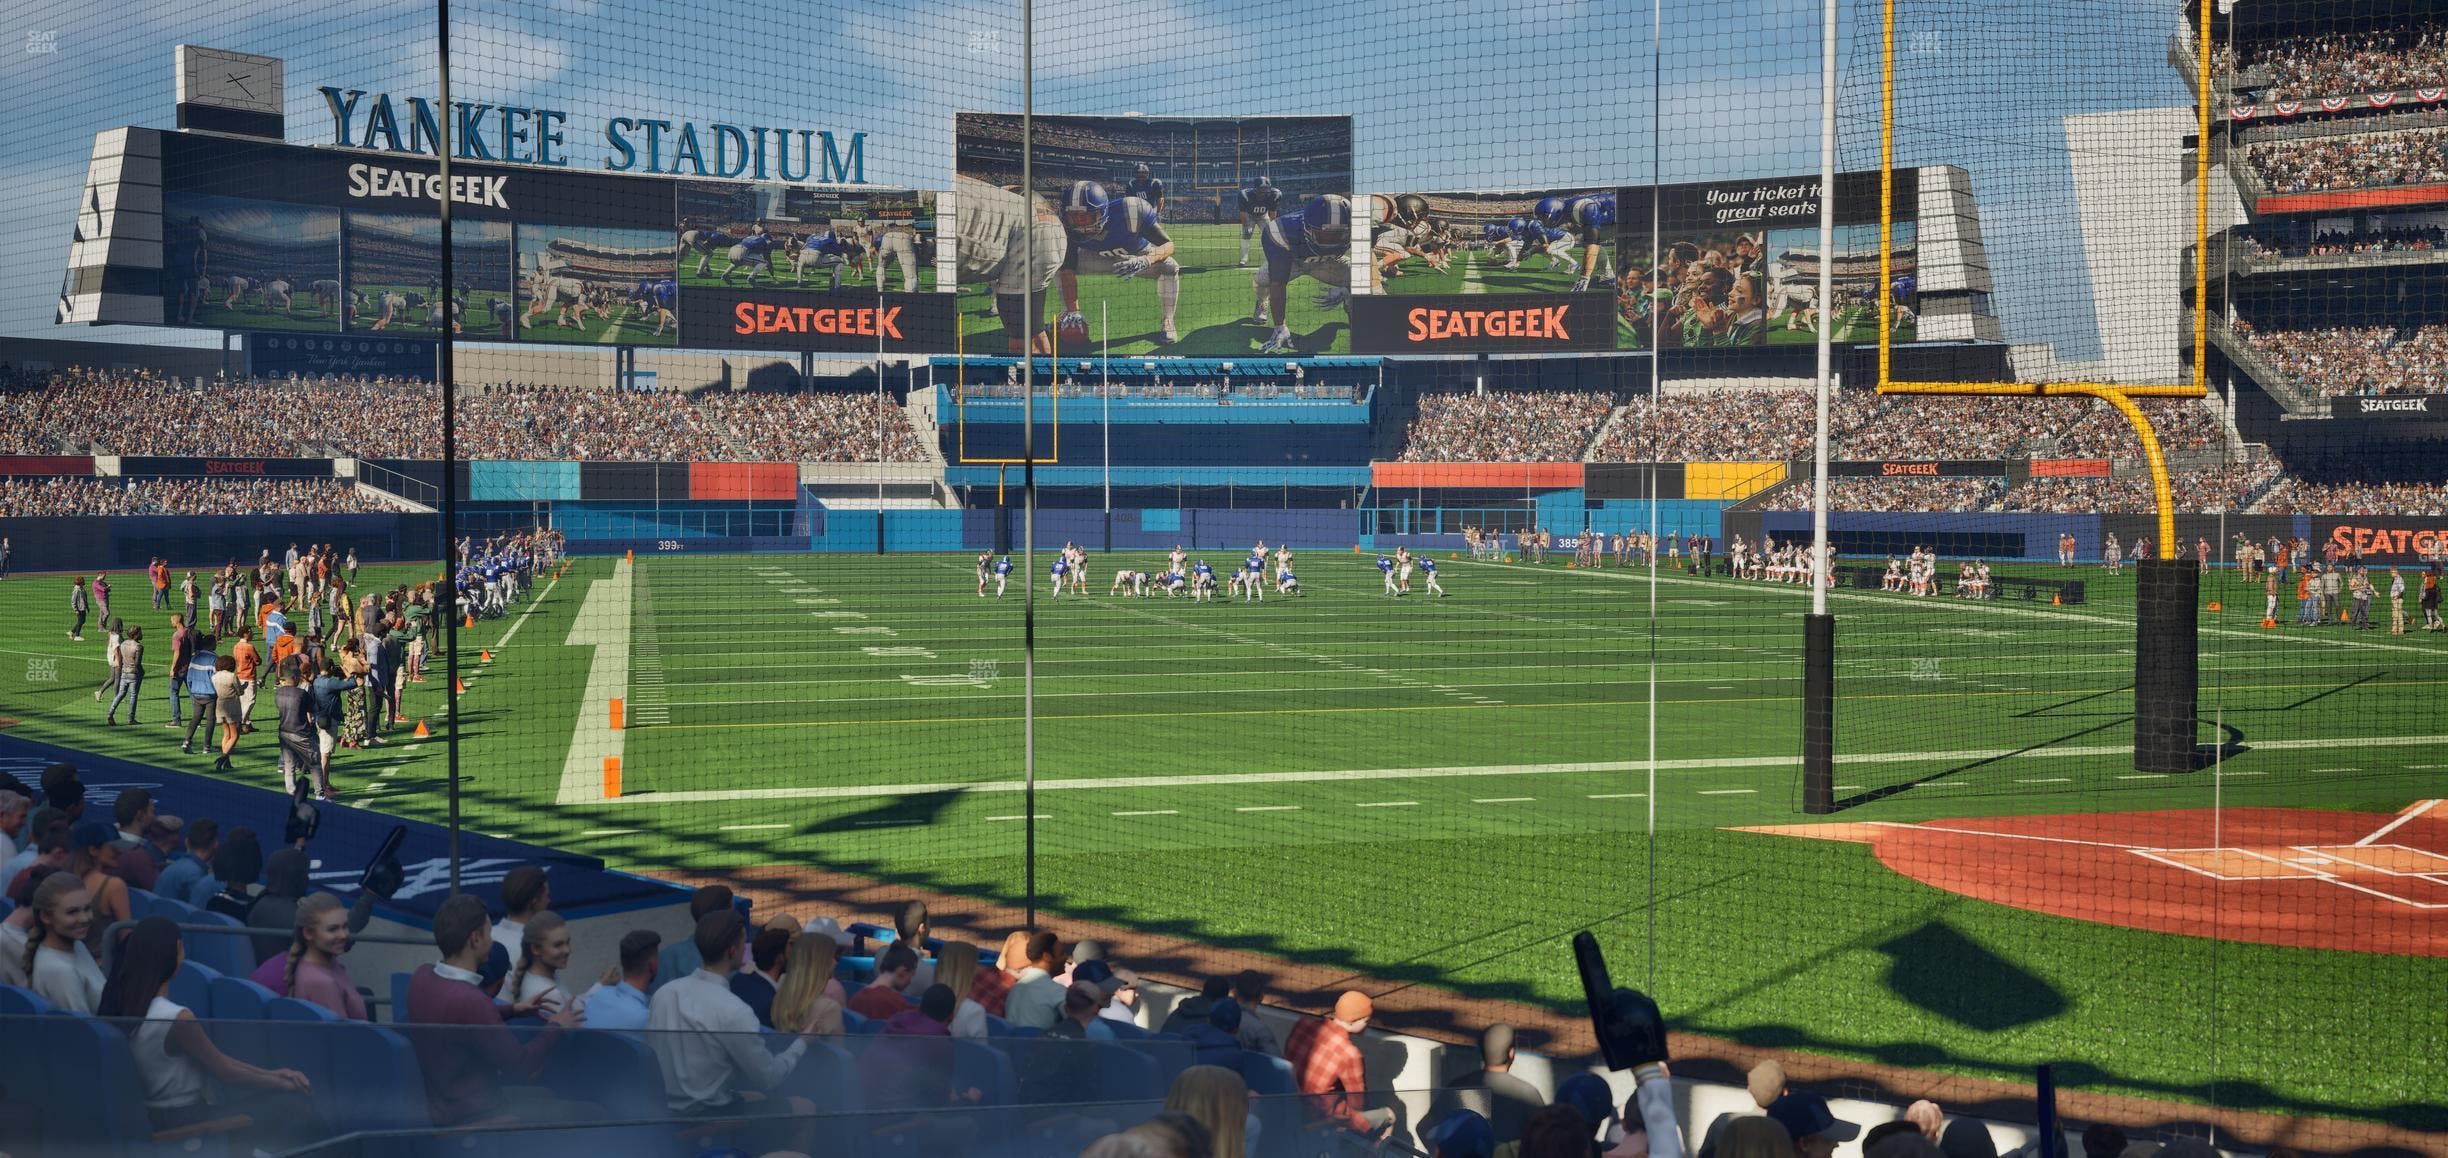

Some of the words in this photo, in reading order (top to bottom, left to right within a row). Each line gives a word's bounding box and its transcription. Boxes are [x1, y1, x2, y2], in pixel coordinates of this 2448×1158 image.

[317, 85, 568, 167] YANKEE
[604, 117, 869, 184] STADIUM
[347, 162, 511, 210] SEATGEEK
[1706, 189, 1750, 206] Your
[1753, 184, 1806, 201] ticket
[1716, 203, 1766, 224] great
[1768, 201, 1817, 217] seats
[735, 301, 904, 340] SEATGEEK
[1407, 304, 1571, 342] SEATGEEK
[2360, 397, 2429, 413] SEATGEEK
[206, 459, 265, 474] SEATGEEK
[1882, 461, 1939, 476] SEATGEEK
[1558, 538, 1577, 549] 385
